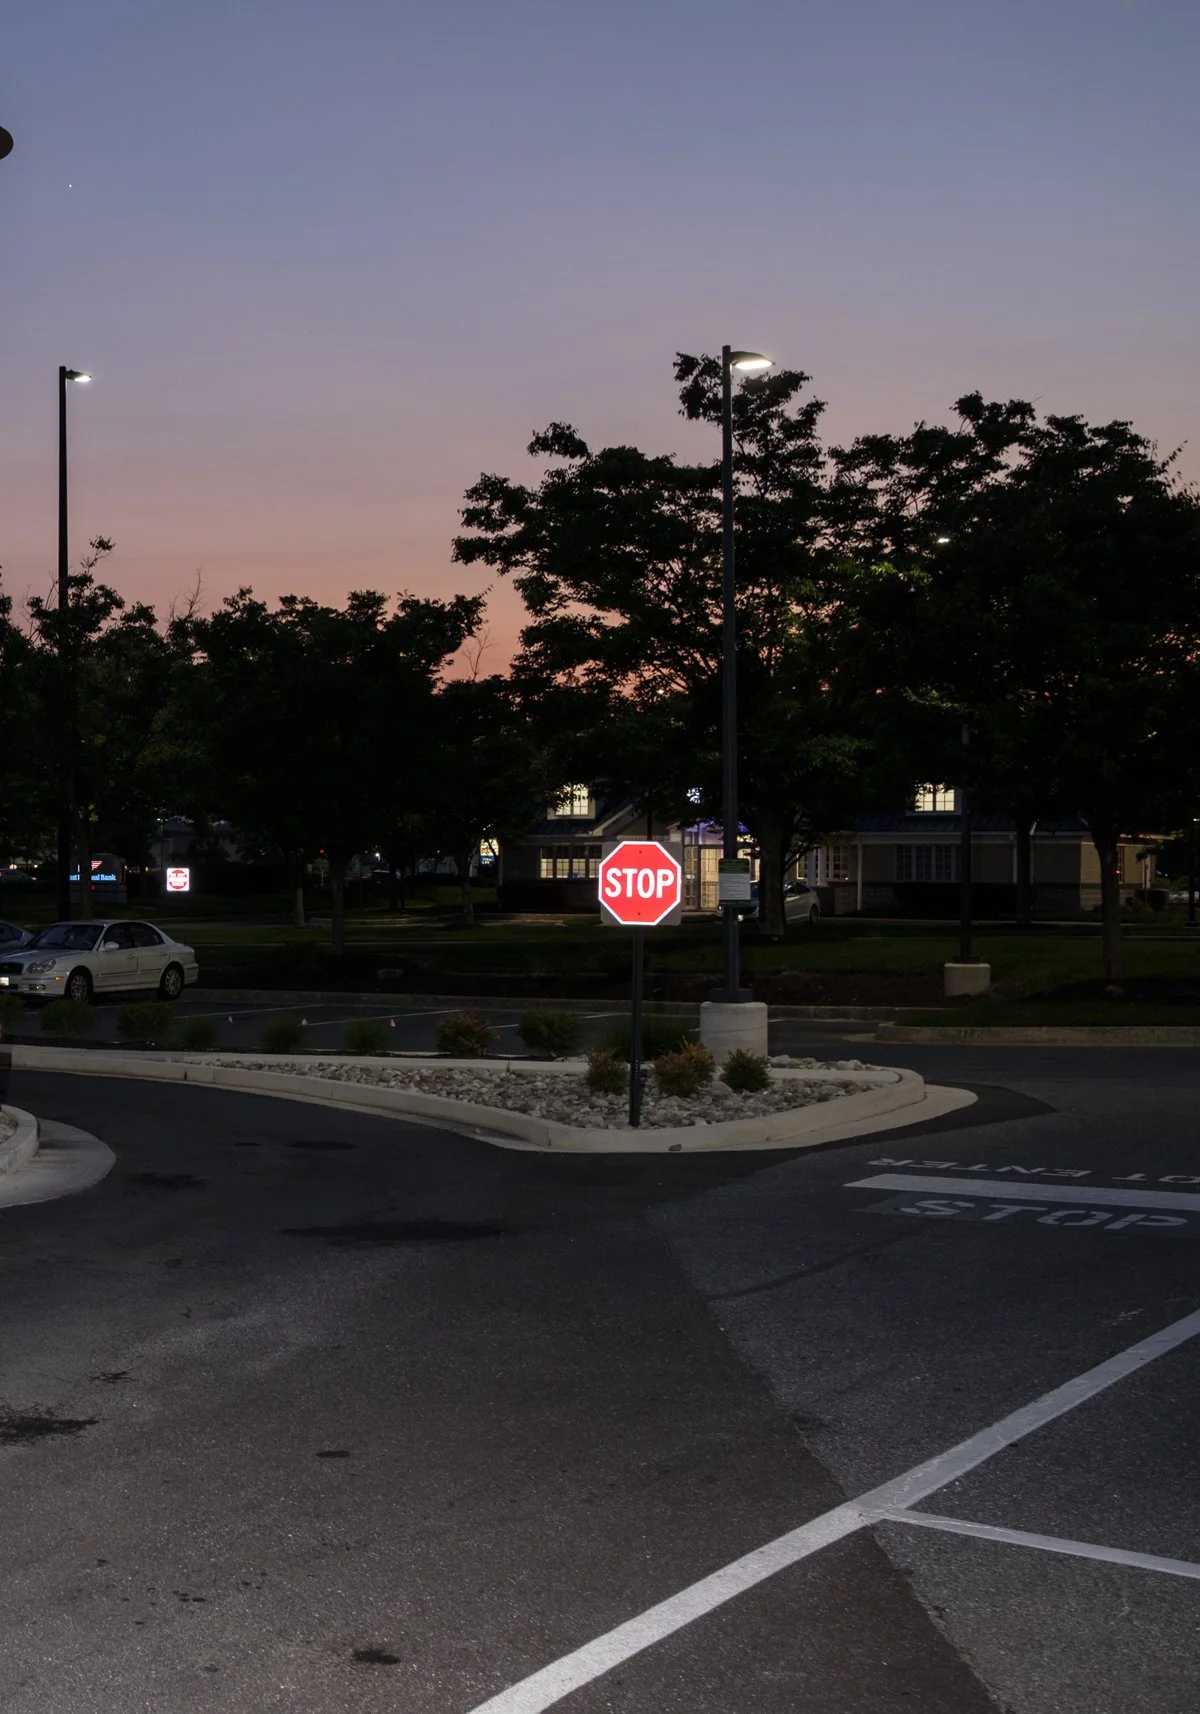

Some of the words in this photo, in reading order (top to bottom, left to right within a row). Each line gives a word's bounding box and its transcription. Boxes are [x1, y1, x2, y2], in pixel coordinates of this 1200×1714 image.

[604, 867, 675, 899] STOP
[867, 1157, 1094, 1178] ENTER
[1111, 1172, 1200, 1184] OT
[899, 1199, 1189, 1230] STOP
